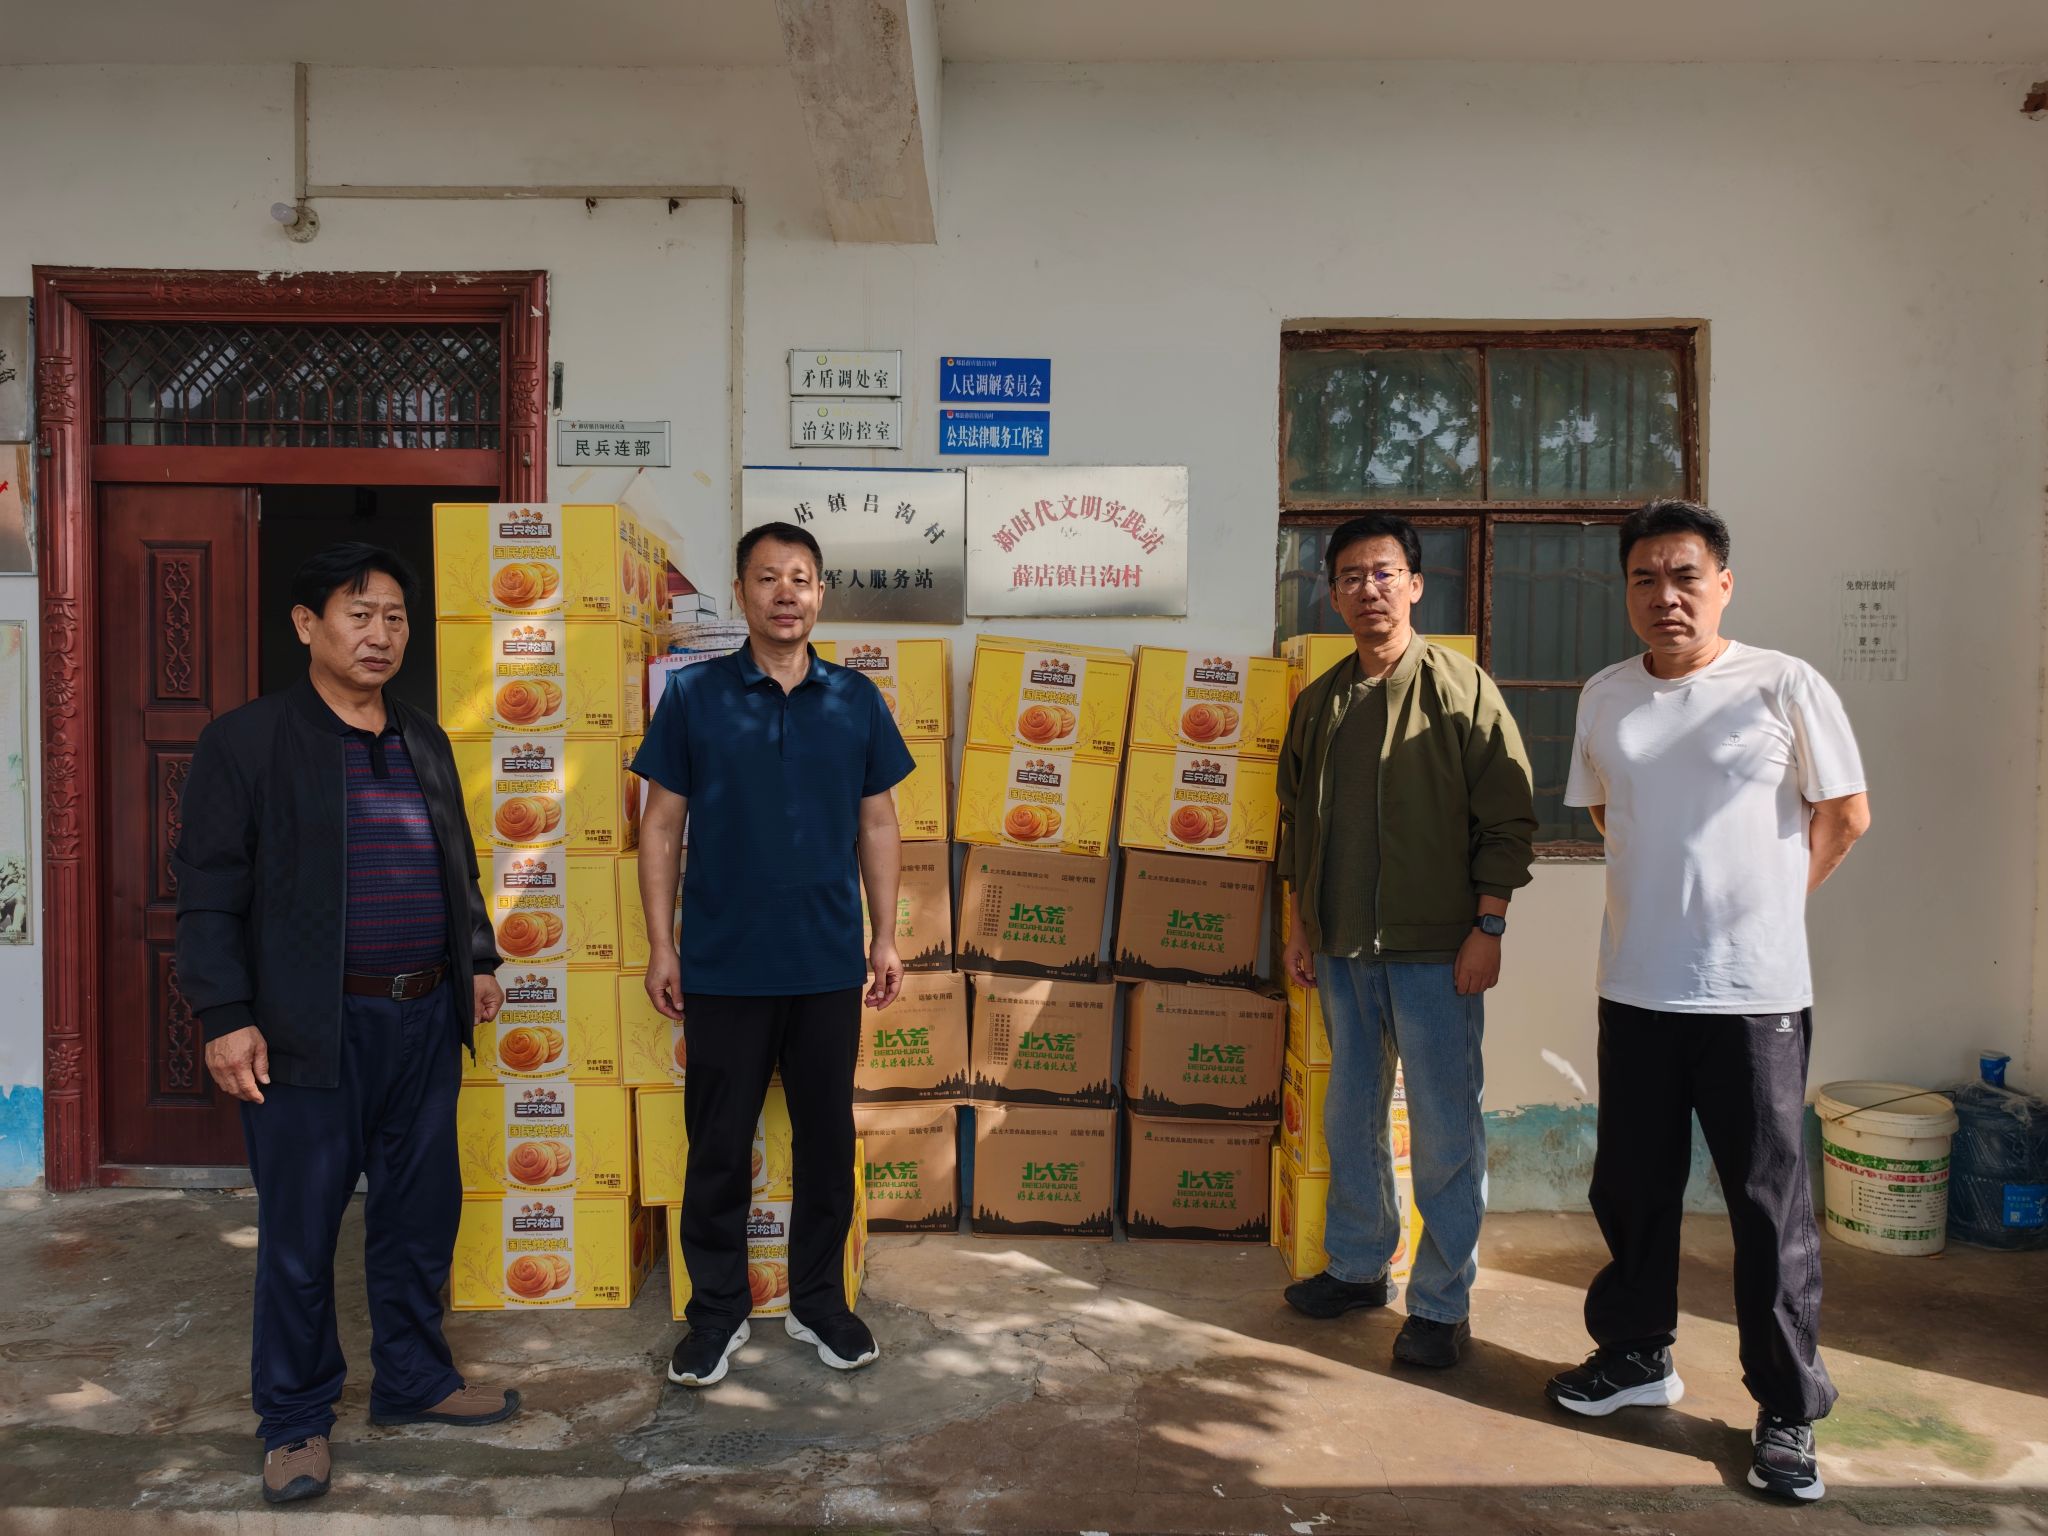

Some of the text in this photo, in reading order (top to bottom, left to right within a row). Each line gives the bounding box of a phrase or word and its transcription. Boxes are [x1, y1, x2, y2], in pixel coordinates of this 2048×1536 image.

[802, 369, 888, 388] 矛盾调处室
[949, 373, 1041, 397] 人民调解委员会
[803, 421, 890, 440] 治安防控室
[946, 425, 1044, 449] 公共法律服务工作室
[575, 439, 650, 457] 民兵连部
[794, 493, 945, 544] 店镇吕沟村
[992, 495, 1165, 555] 新时代文明实践站
[501, 524, 550, 536] 三只松鼠
[493, 545, 560, 560] 国民烘焙礼
[824, 568, 934, 589] 军人服务站
[1012, 564, 1143, 588] 薛店镇吕沟村
[1846, 580, 1896, 591] 免费开放时间
[504, 641, 554, 653] 三只松鼠
[497, 663, 564, 676] 国民烘焙礼
[846, 658, 888, 669] 三只松鼠
[1031, 670, 1075, 686] 三只松鼠
[1195, 669, 1237, 683] 三只松鼠
[1023, 688, 1079, 706] 国民烘焙礼
[1185, 687, 1243, 704] 国民烘焙礼
[503, 759, 553, 770] 三只松鼠
[1017, 771, 1060, 786] 三只松鼠
[1183, 771, 1226, 785] 三只松鼠
[496, 780, 563, 794] 国民烘焙礼
[1009, 788, 1065, 805] 国民烘焙礼
[1174, 788, 1231, 805] 国民烘焙礼
[505, 874, 555, 885] 三只松鼠
[1061, 874, 1096, 884] 运输专用箱
[1220, 881, 1255, 892] 运输专用箱
[497, 895, 564, 909] 国民烘焙礼
[1008, 903, 1066, 925] 北大荒
[1167, 909, 1225, 933] 北大荒
[1008, 922, 1063, 933] BEIDAHUANG
[1166, 929, 1222, 941] BEIDAHUANG
[507, 989, 556, 1000] 三只松鼠
[919, 992, 952, 1001] 运输专用箱
[1069, 1001, 1104, 1009] 运输专用箱
[499, 1010, 565, 1024] 国民烘焙礼
[1239, 1012, 1274, 1020] 运输专用箱
[873, 1027, 929, 1048] 北大荒
[1019, 1032, 1075, 1052] 北大荒
[874, 1048, 929, 1056] BEIDAHUANG
[1019, 1051, 1074, 1060] BEIDAHUANG
[1188, 1043, 1246, 1064] 北大荒
[1187, 1064, 1244, 1072] BEIDAHUANG
[516, 1103, 563, 1115] 三只松鼠
[508, 1124, 573, 1138] 国民烘焙礼
[909, 1125, 943, 1135] 运输专用箱
[1070, 1129, 1105, 1137] 运输专用箱
[865, 1161, 918, 1180] 北大荒
[1022, 1162, 1079, 1181] 北大荒
[1022, 1182, 1077, 1190] BEIDAHUANG
[1177, 1170, 1234, 1190] 北大荒
[1177, 1189, 1233, 1198] BEIDAHUANG
[514, 1218, 562, 1229] 三只松鼠
[747, 1224, 782, 1236] 只松鼠
[506, 1238, 572, 1252] 国民烘焙礼
